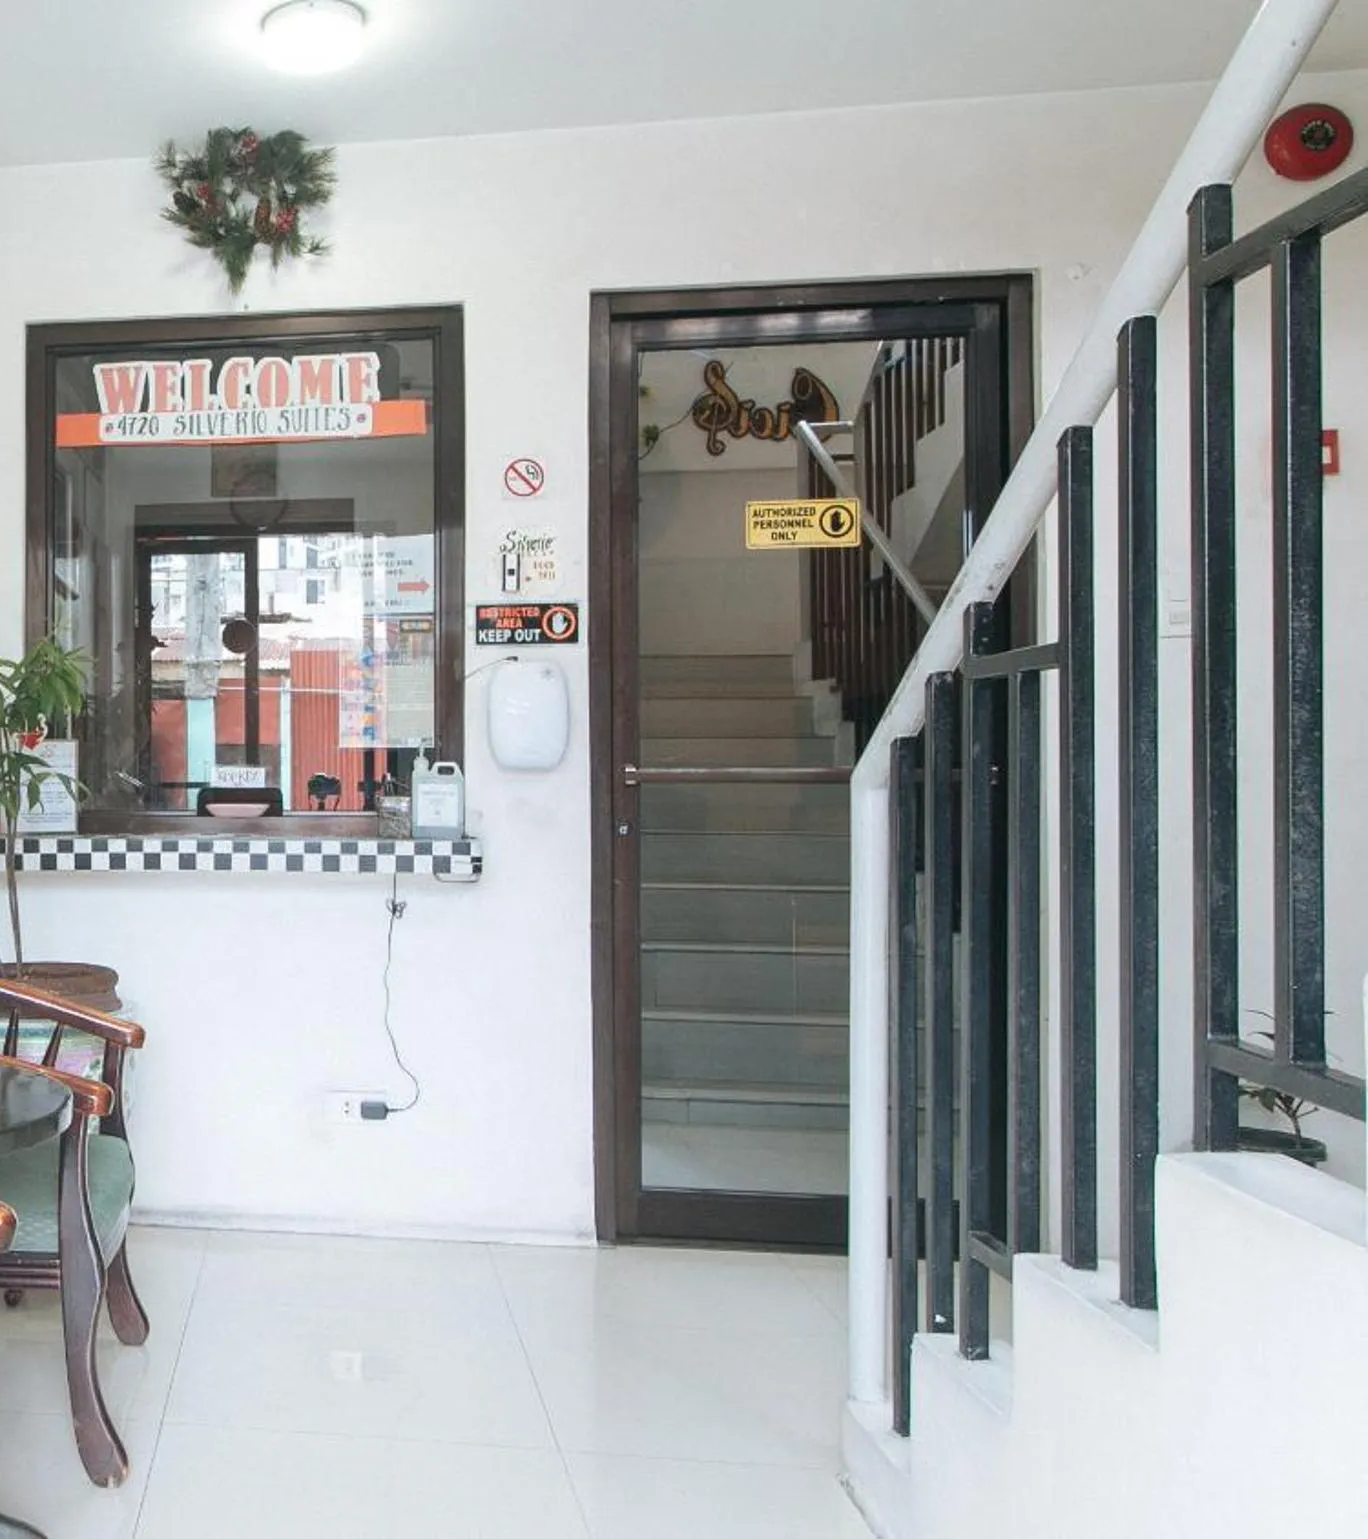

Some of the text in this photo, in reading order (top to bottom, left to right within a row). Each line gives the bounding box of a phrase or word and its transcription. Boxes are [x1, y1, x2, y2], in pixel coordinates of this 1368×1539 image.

[97, 354, 379, 414] WELCOME
[116, 406, 352, 436] 4720 SILVERIO SUITES
[752, 506, 816, 518] AUTHORIZED
[752, 519, 814, 529] PERSONNEL
[771, 531, 799, 541] ONLY
[478, 606, 540, 619] RESTRICTED
[496, 617, 523, 628] AREA
[478, 628, 541, 642] KEEP OUT
